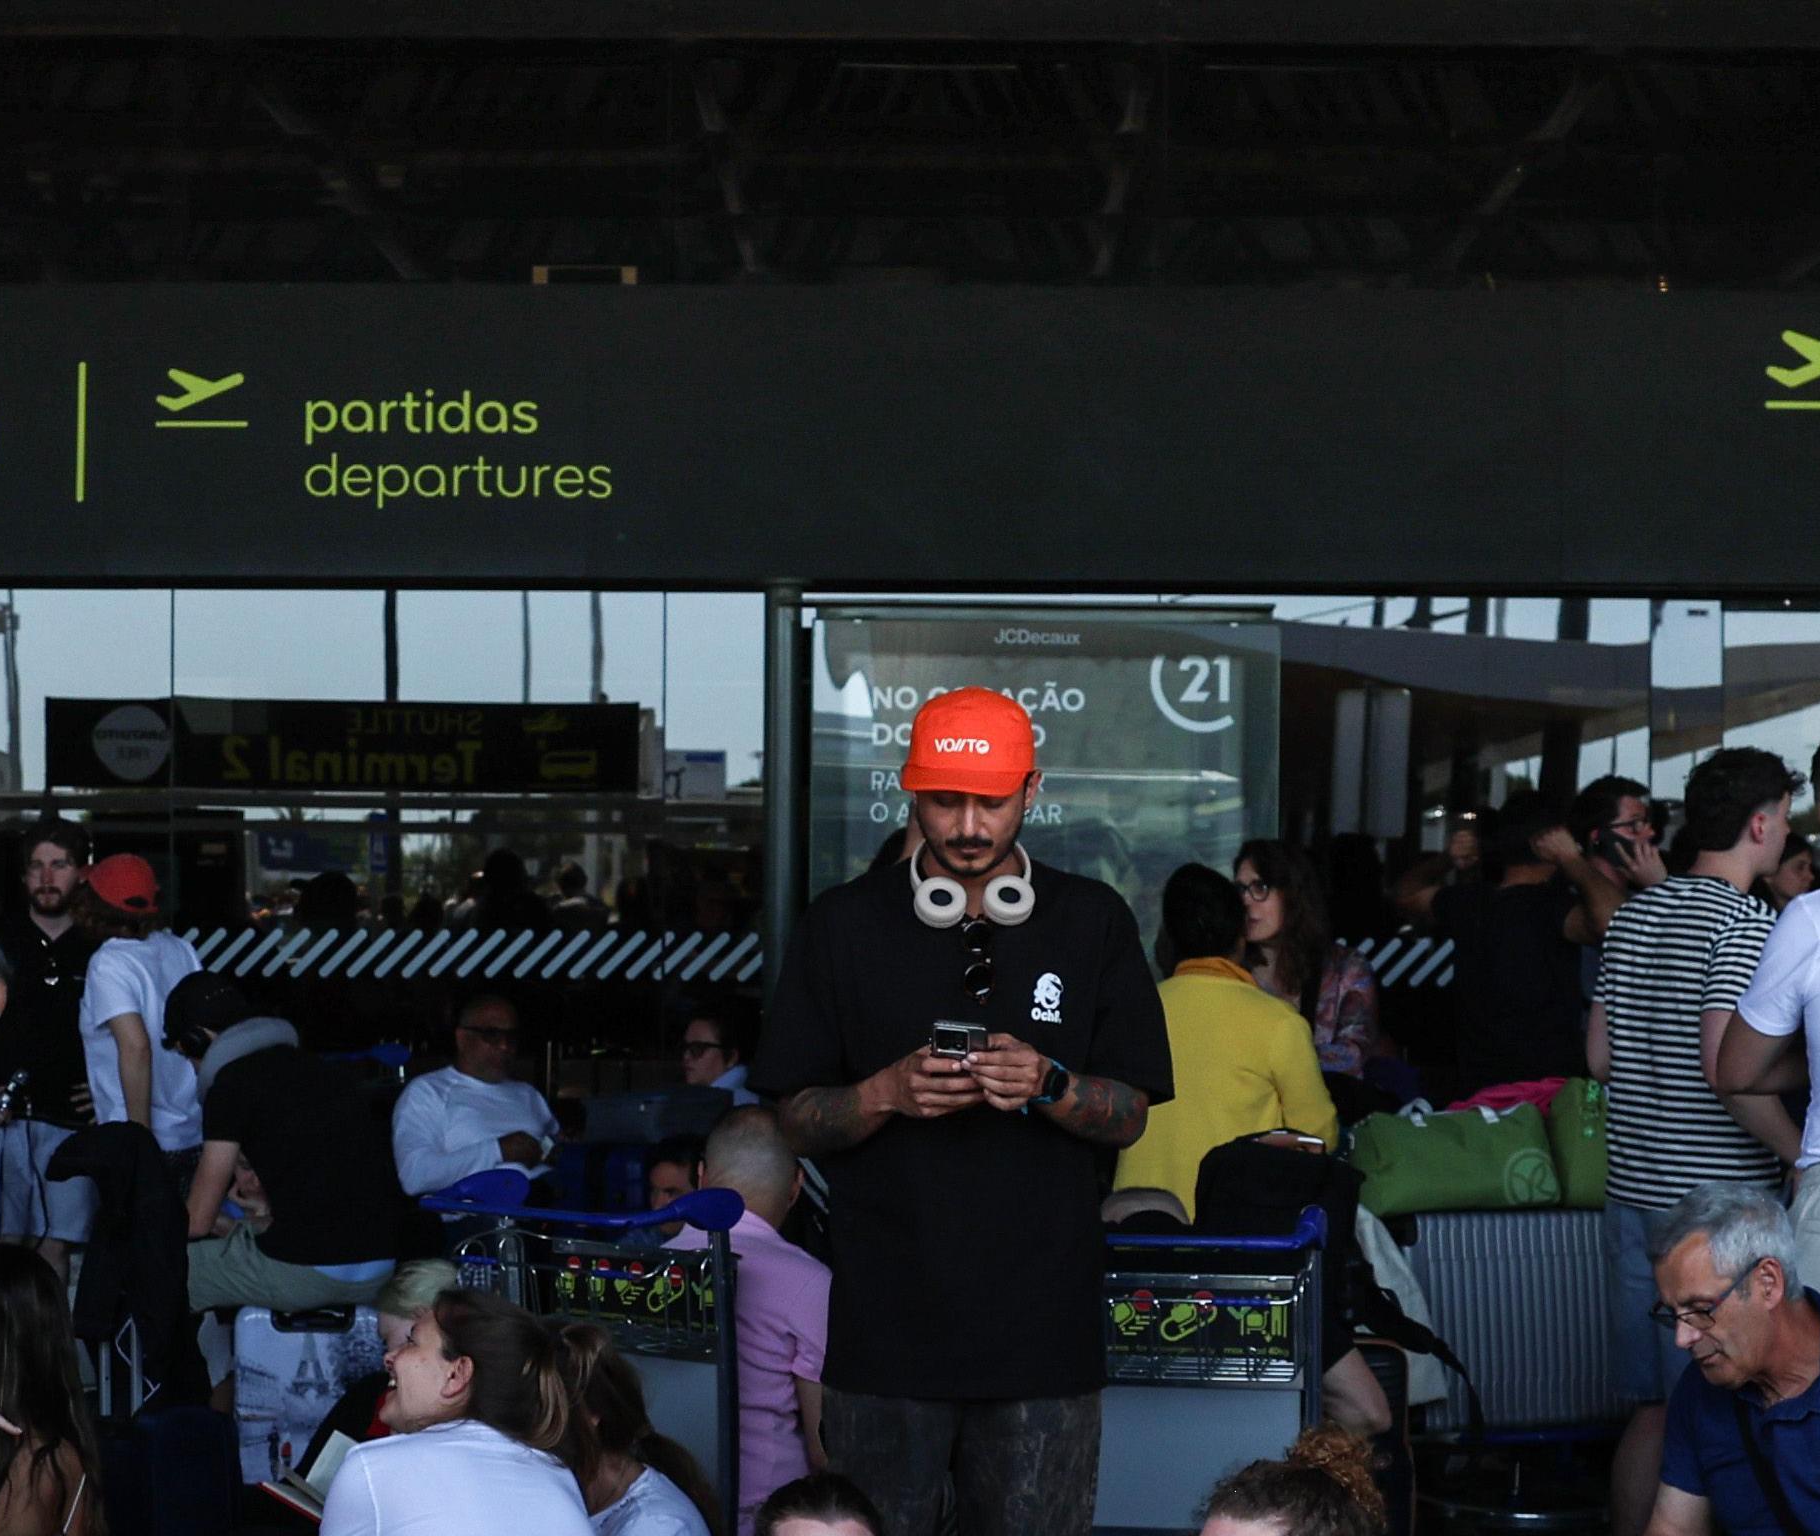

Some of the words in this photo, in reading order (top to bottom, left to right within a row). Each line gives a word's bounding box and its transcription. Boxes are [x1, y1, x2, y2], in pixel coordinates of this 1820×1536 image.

[304, 389, 541, 446] partidas
[305, 456, 615, 510] departures
[994, 628, 1081, 646] JCDecaux
[872, 685, 918, 711] NO
